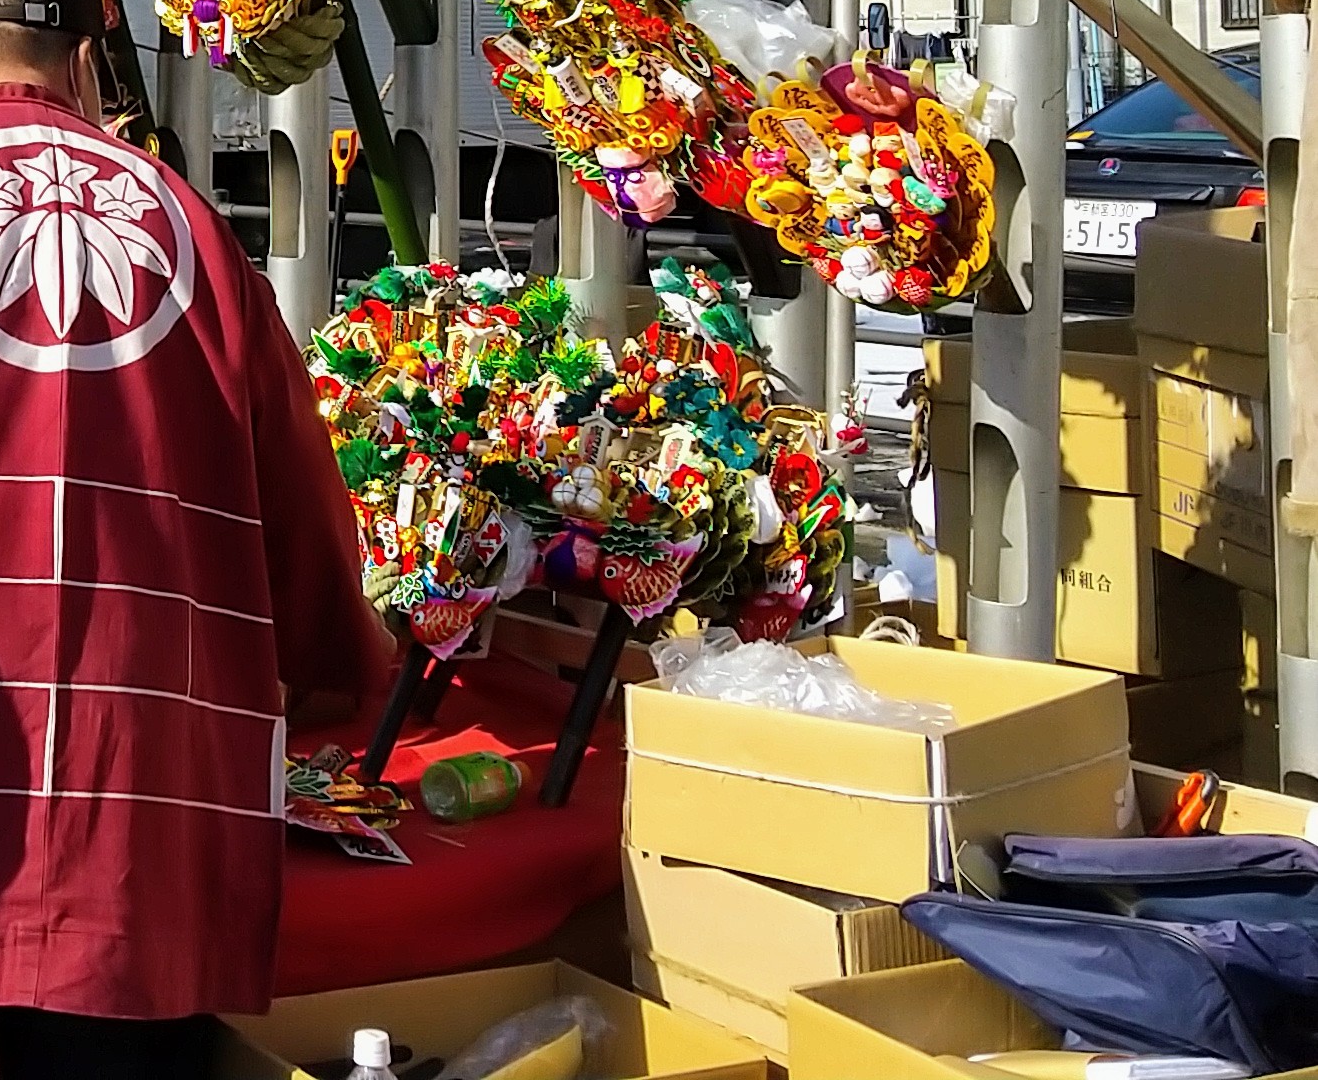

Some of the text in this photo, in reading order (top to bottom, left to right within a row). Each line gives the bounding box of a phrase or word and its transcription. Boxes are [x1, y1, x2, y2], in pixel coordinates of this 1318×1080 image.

[1077, 220, 1130, 249] 51-5
[1061, 568, 1112, 593] 同組合
